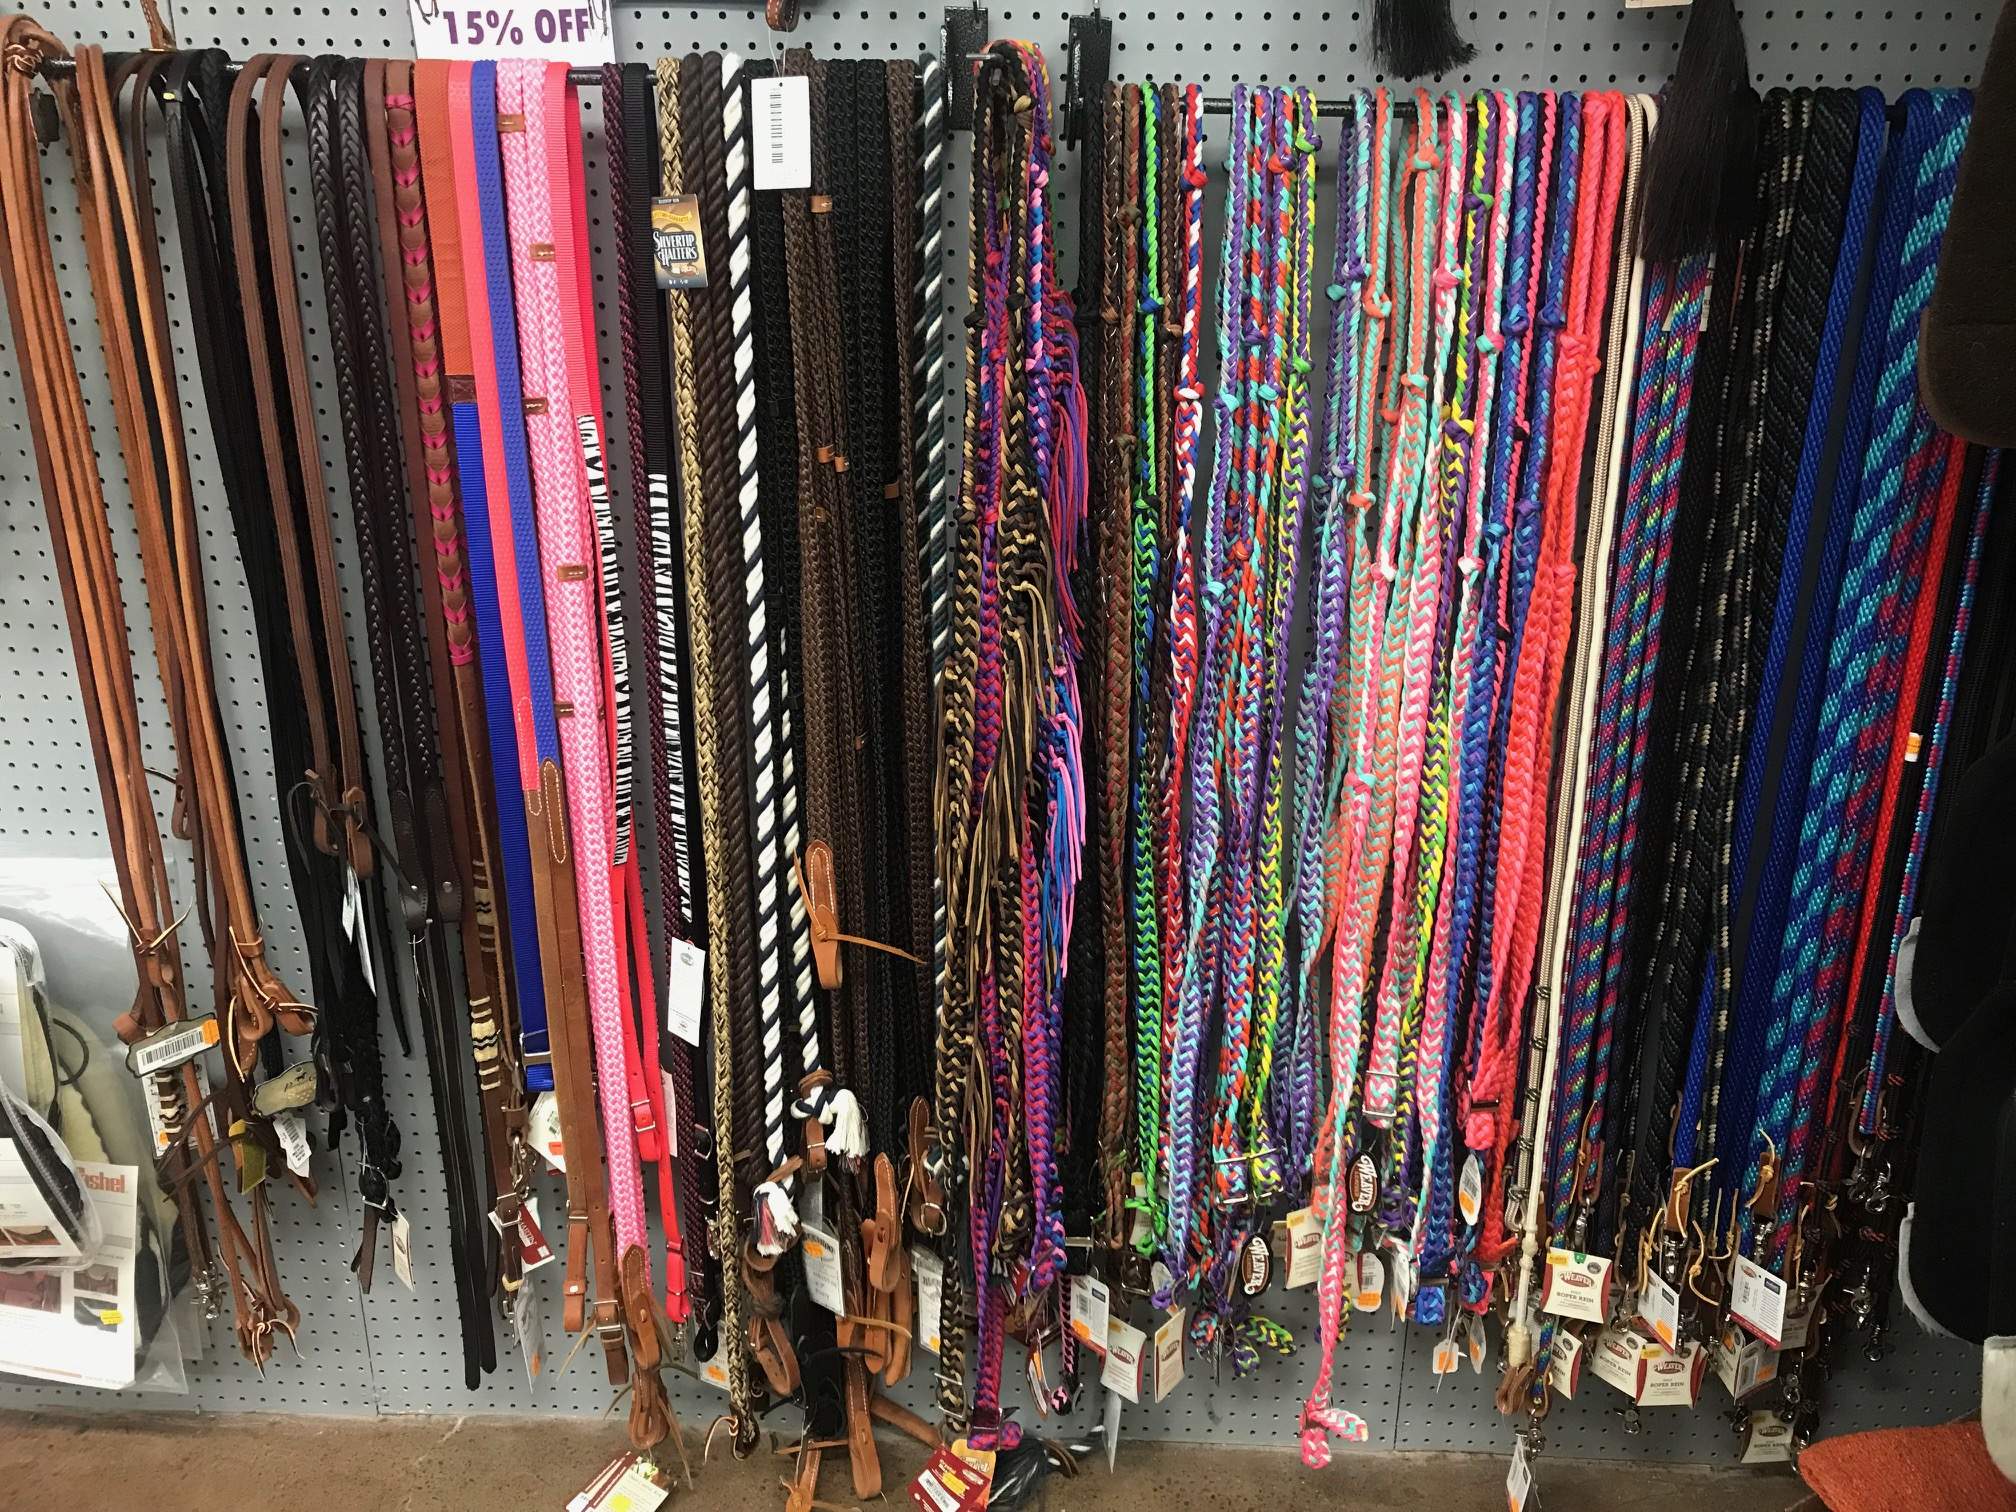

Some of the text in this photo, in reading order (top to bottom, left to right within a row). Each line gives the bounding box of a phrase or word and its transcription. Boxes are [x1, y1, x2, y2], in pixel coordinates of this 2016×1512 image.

[442, 8, 590, 46] 15% OFF
[652, 231, 695, 252] SILVERTIP
[657, 246, 698, 267] HALTERS
[1352, 1154, 1378, 1212] WEAVER
[1244, 1236, 1270, 1295] WEAVER
[1559, 1272, 1594, 1287] WEAVER
[1556, 1291, 1578, 1300] ROPER
[1578, 1295, 1594, 1304] REIN
[1109, 1344, 1136, 1365] WEAVER
[1654, 1360, 1686, 1375] WEAVER
[1650, 1381, 1669, 1389] ROPER
